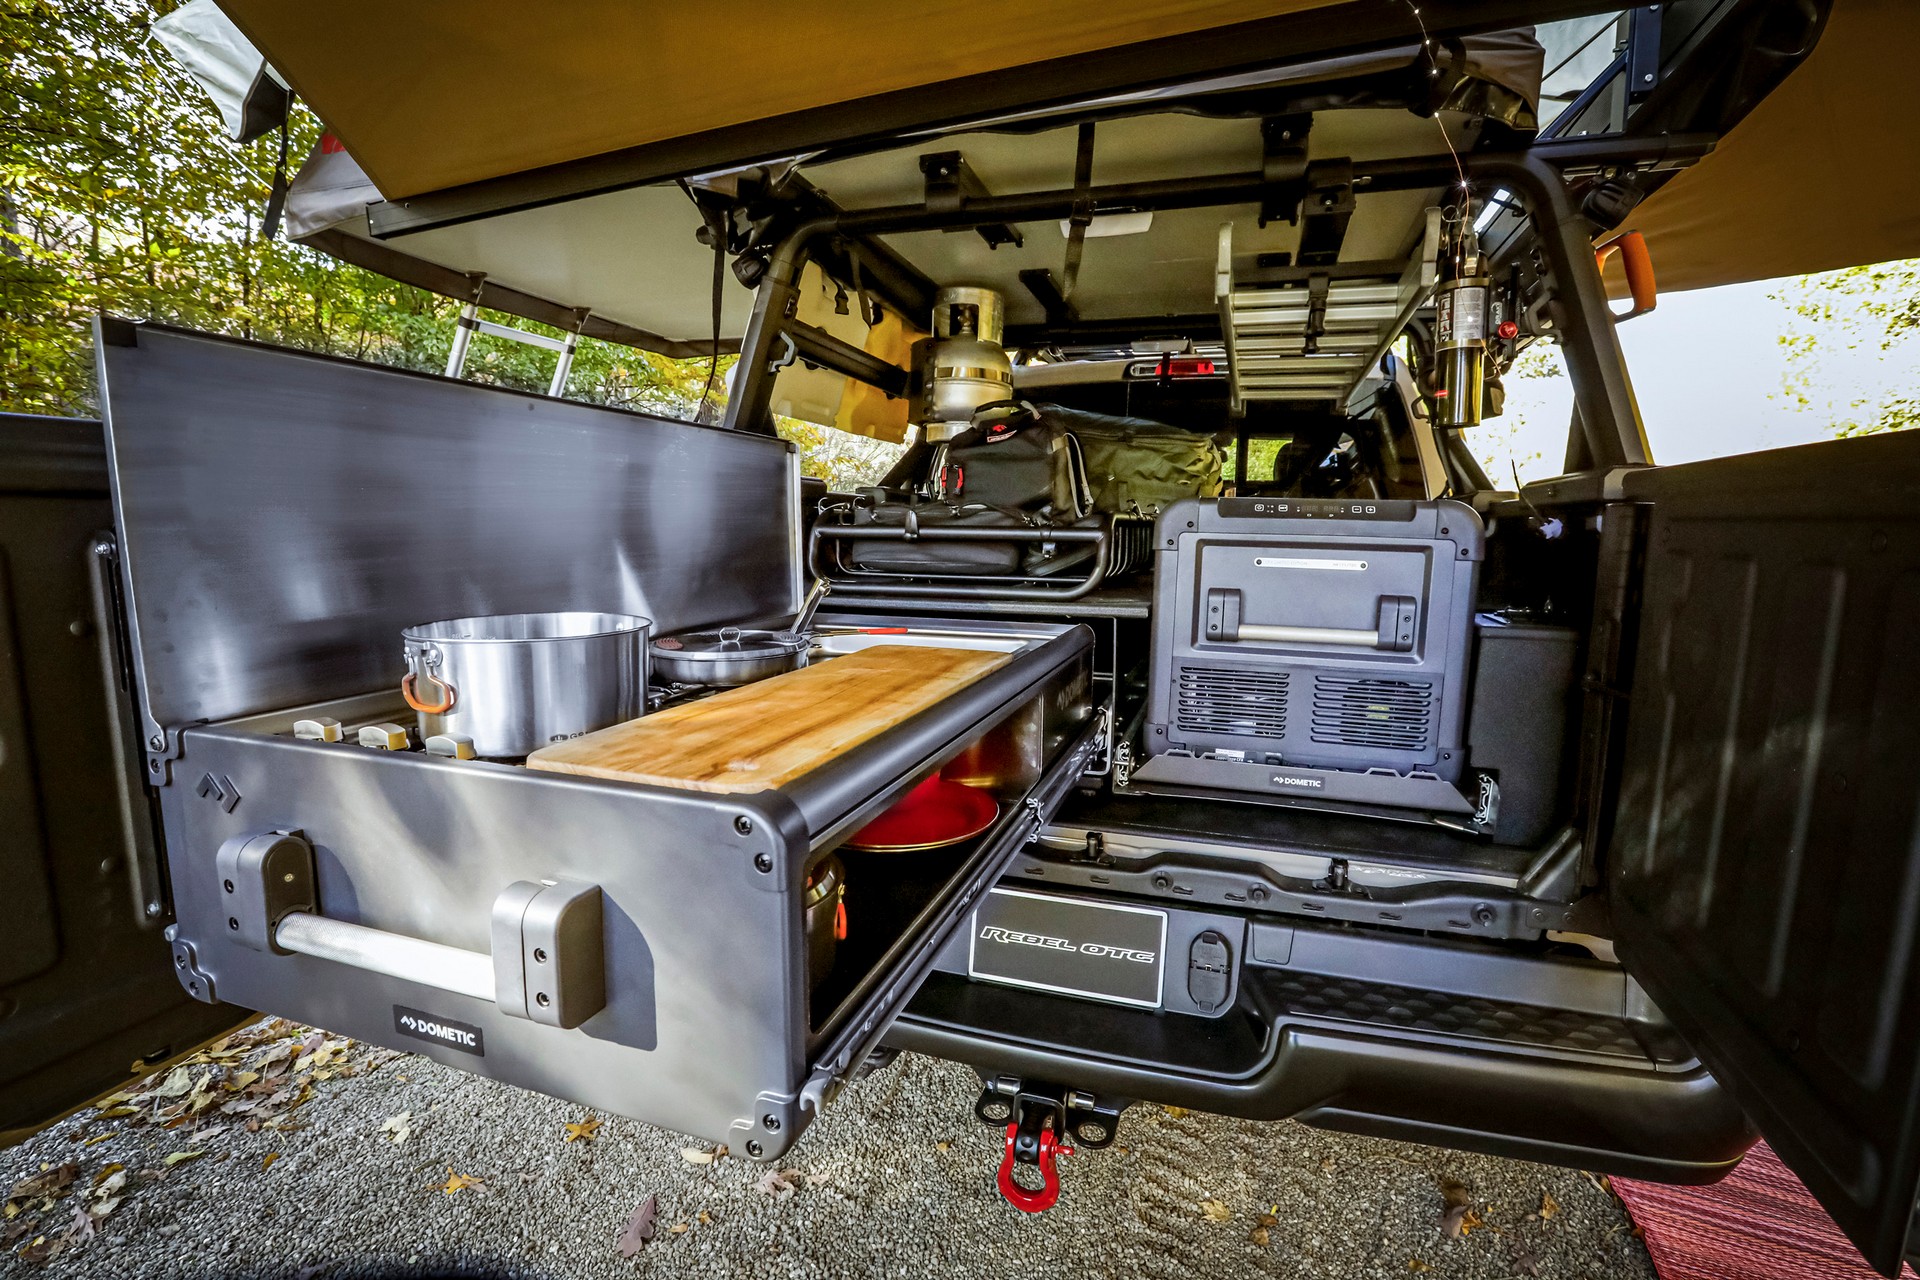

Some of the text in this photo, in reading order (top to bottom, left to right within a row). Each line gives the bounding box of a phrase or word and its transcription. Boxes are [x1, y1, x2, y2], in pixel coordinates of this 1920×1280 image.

[1284, 777, 1322, 788] DOMETIC
[980, 926, 1155, 963] REBEL OTG
[417, 1019, 477, 1047] DOMETIC
